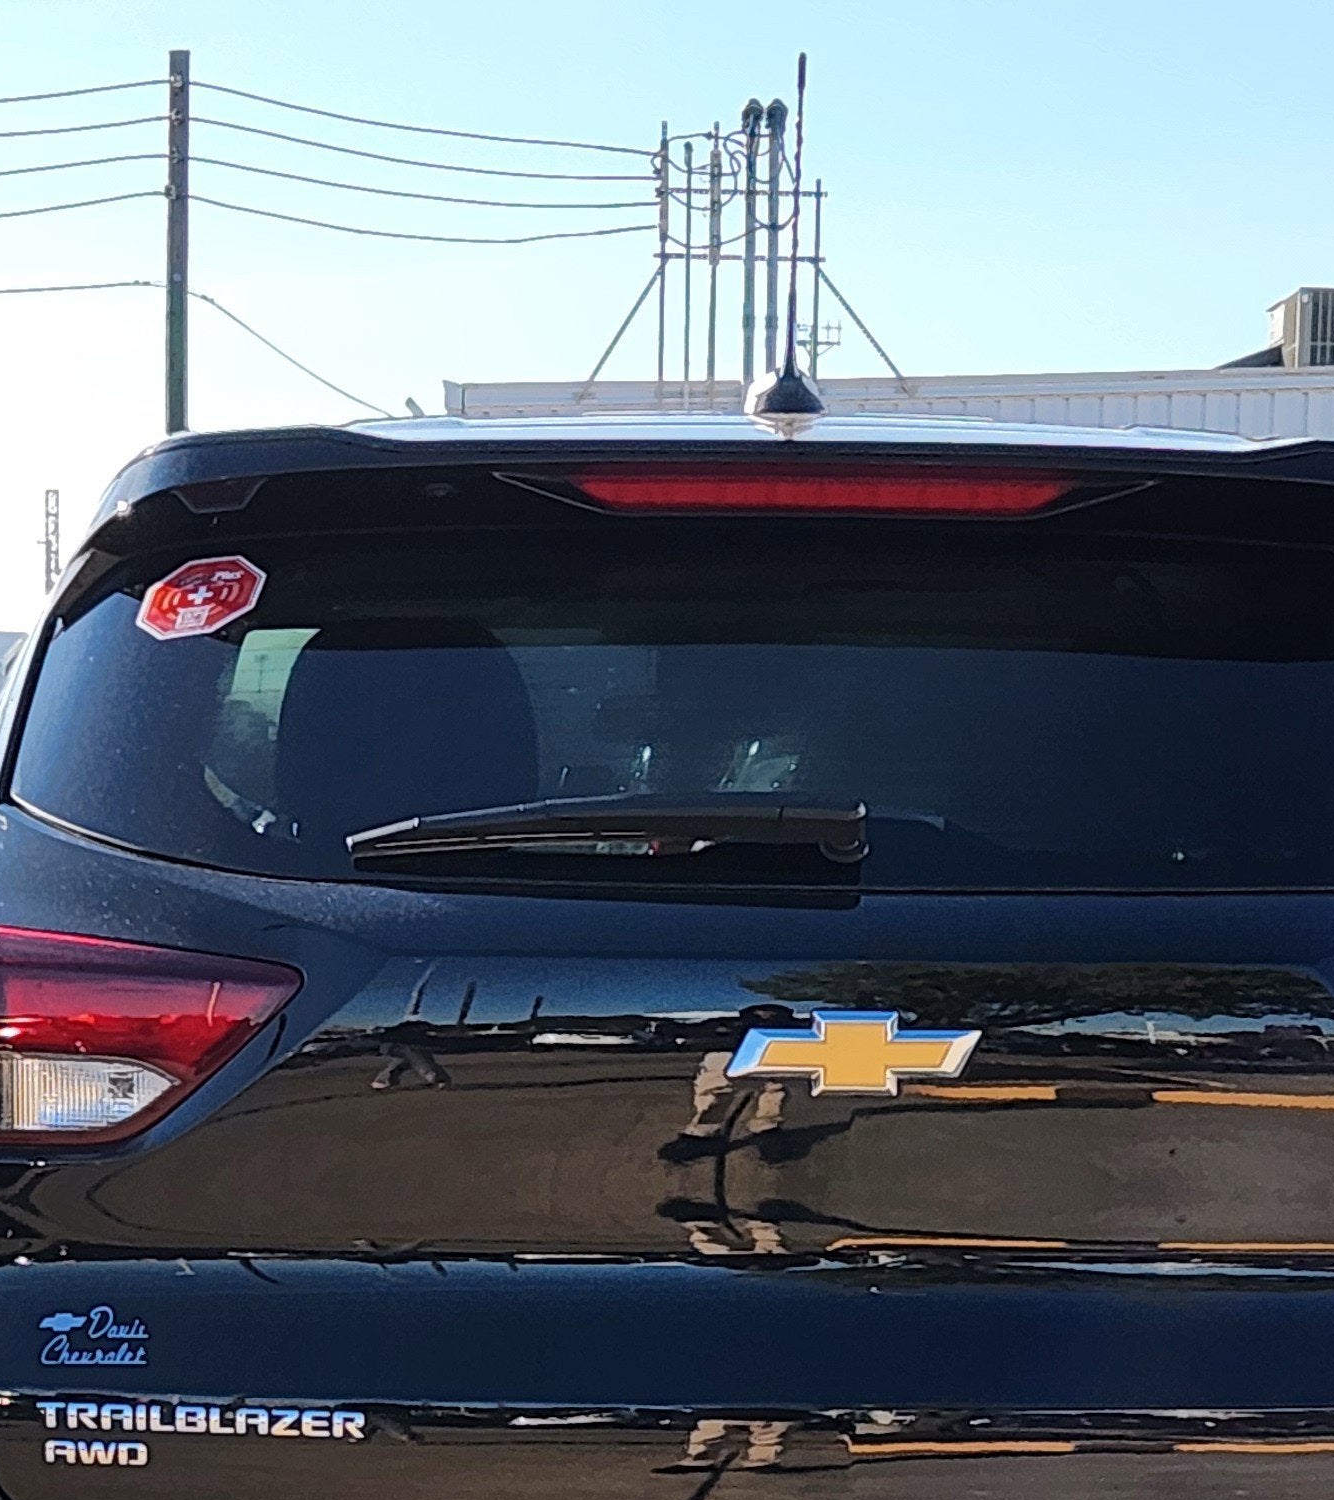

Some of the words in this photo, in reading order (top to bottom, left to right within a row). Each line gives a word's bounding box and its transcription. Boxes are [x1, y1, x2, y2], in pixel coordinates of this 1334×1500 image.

[88, 1305, 149, 1338] Davis
[40, 1334, 147, 1365] Chevrolet
[35, 1401, 366, 1439] TRAILBLAZER
[44, 1439, 149, 1467] AWD
